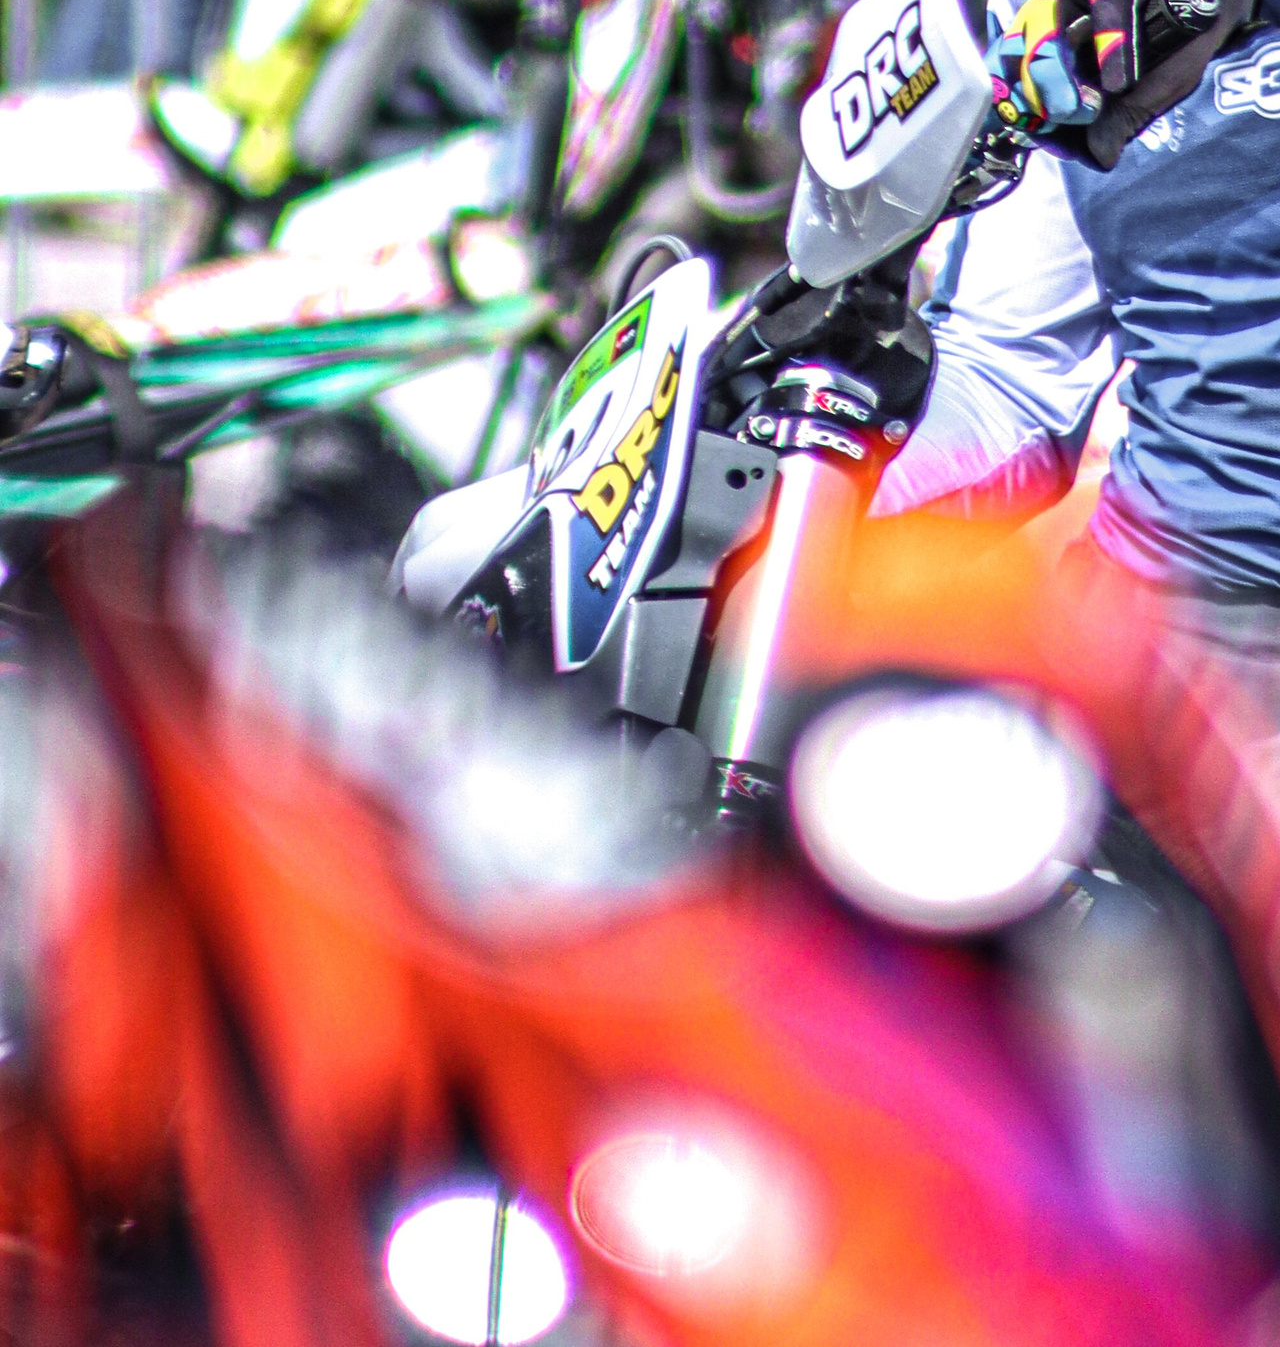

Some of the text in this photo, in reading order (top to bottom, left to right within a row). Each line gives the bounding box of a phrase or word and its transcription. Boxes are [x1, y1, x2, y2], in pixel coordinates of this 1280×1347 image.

[832, 0, 930, 159] DRC
[889, 59, 939, 120] TEAM
[570, 344, 680, 536] DRC
[804, 387, 870, 422] XTRIG
[586, 467, 656, 591] TEAM
